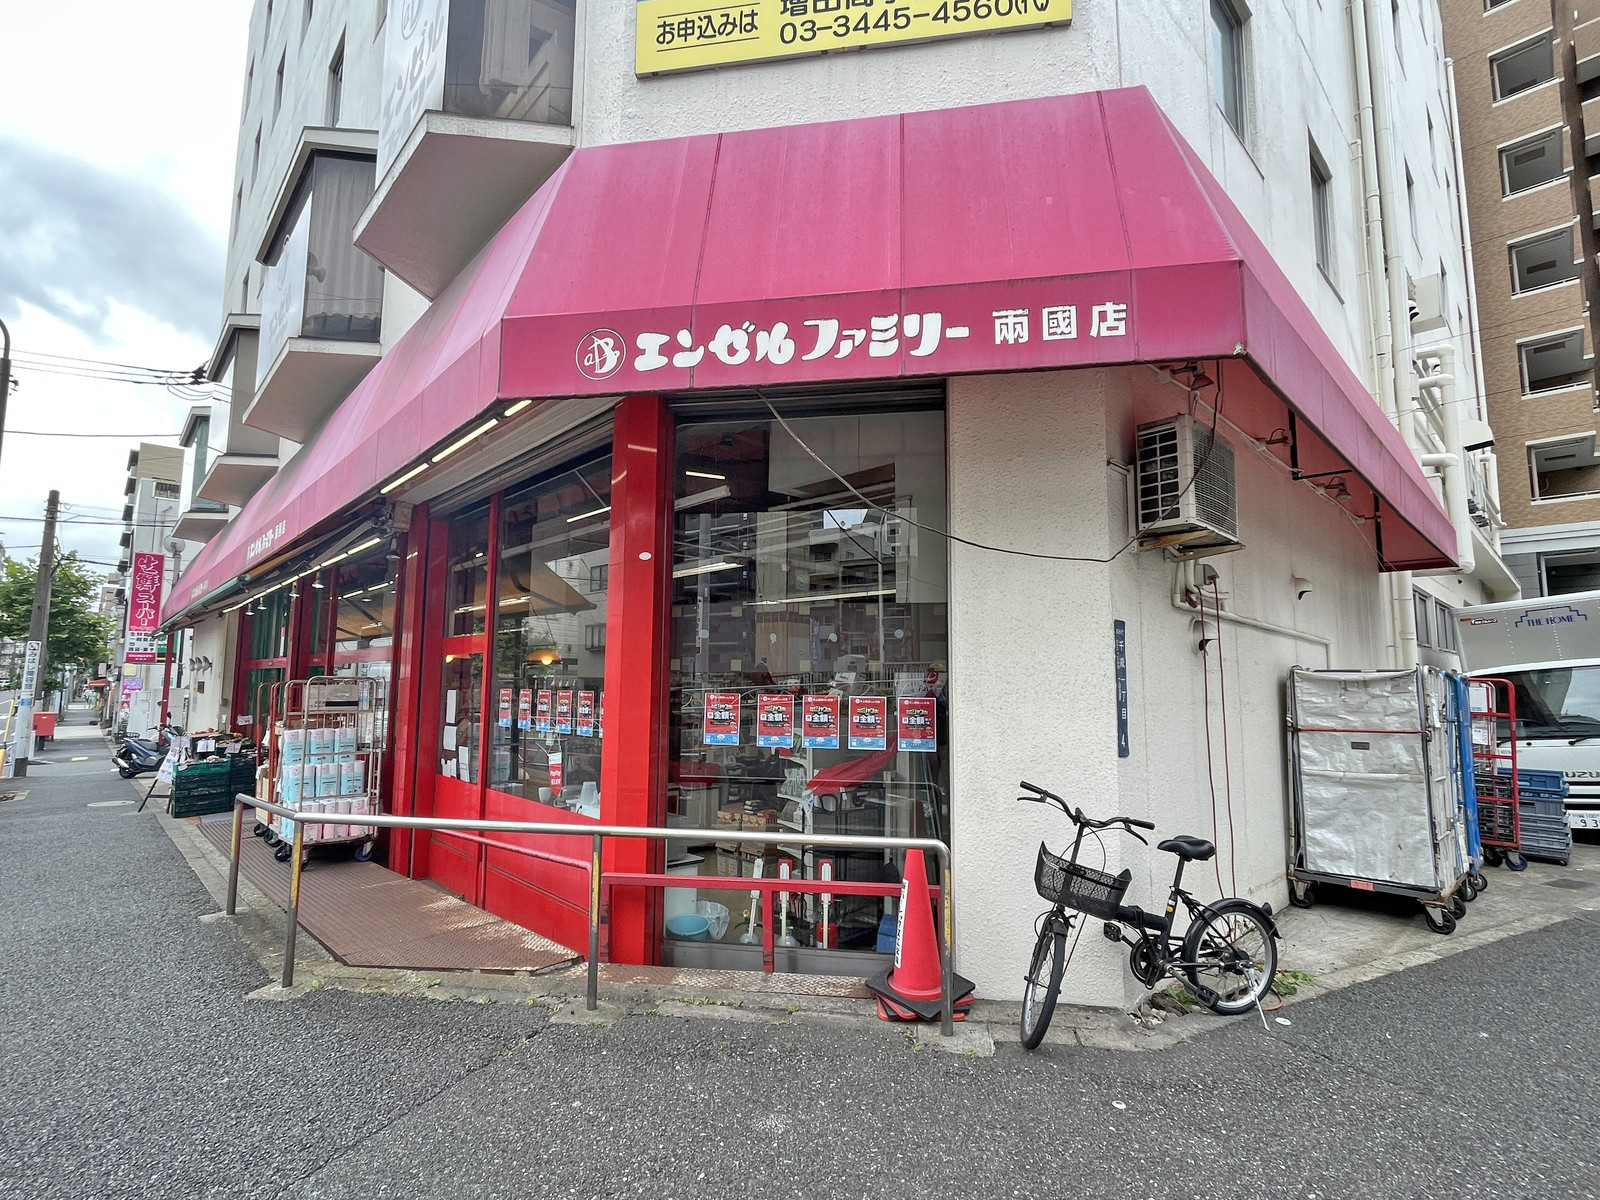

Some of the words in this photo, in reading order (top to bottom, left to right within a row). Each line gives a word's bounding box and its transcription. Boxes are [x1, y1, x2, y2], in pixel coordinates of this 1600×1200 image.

[656, 9, 759, 45] お申込みは
[1526, 619, 1543, 627] THE
[1546, 614, 1575, 625] HOME
